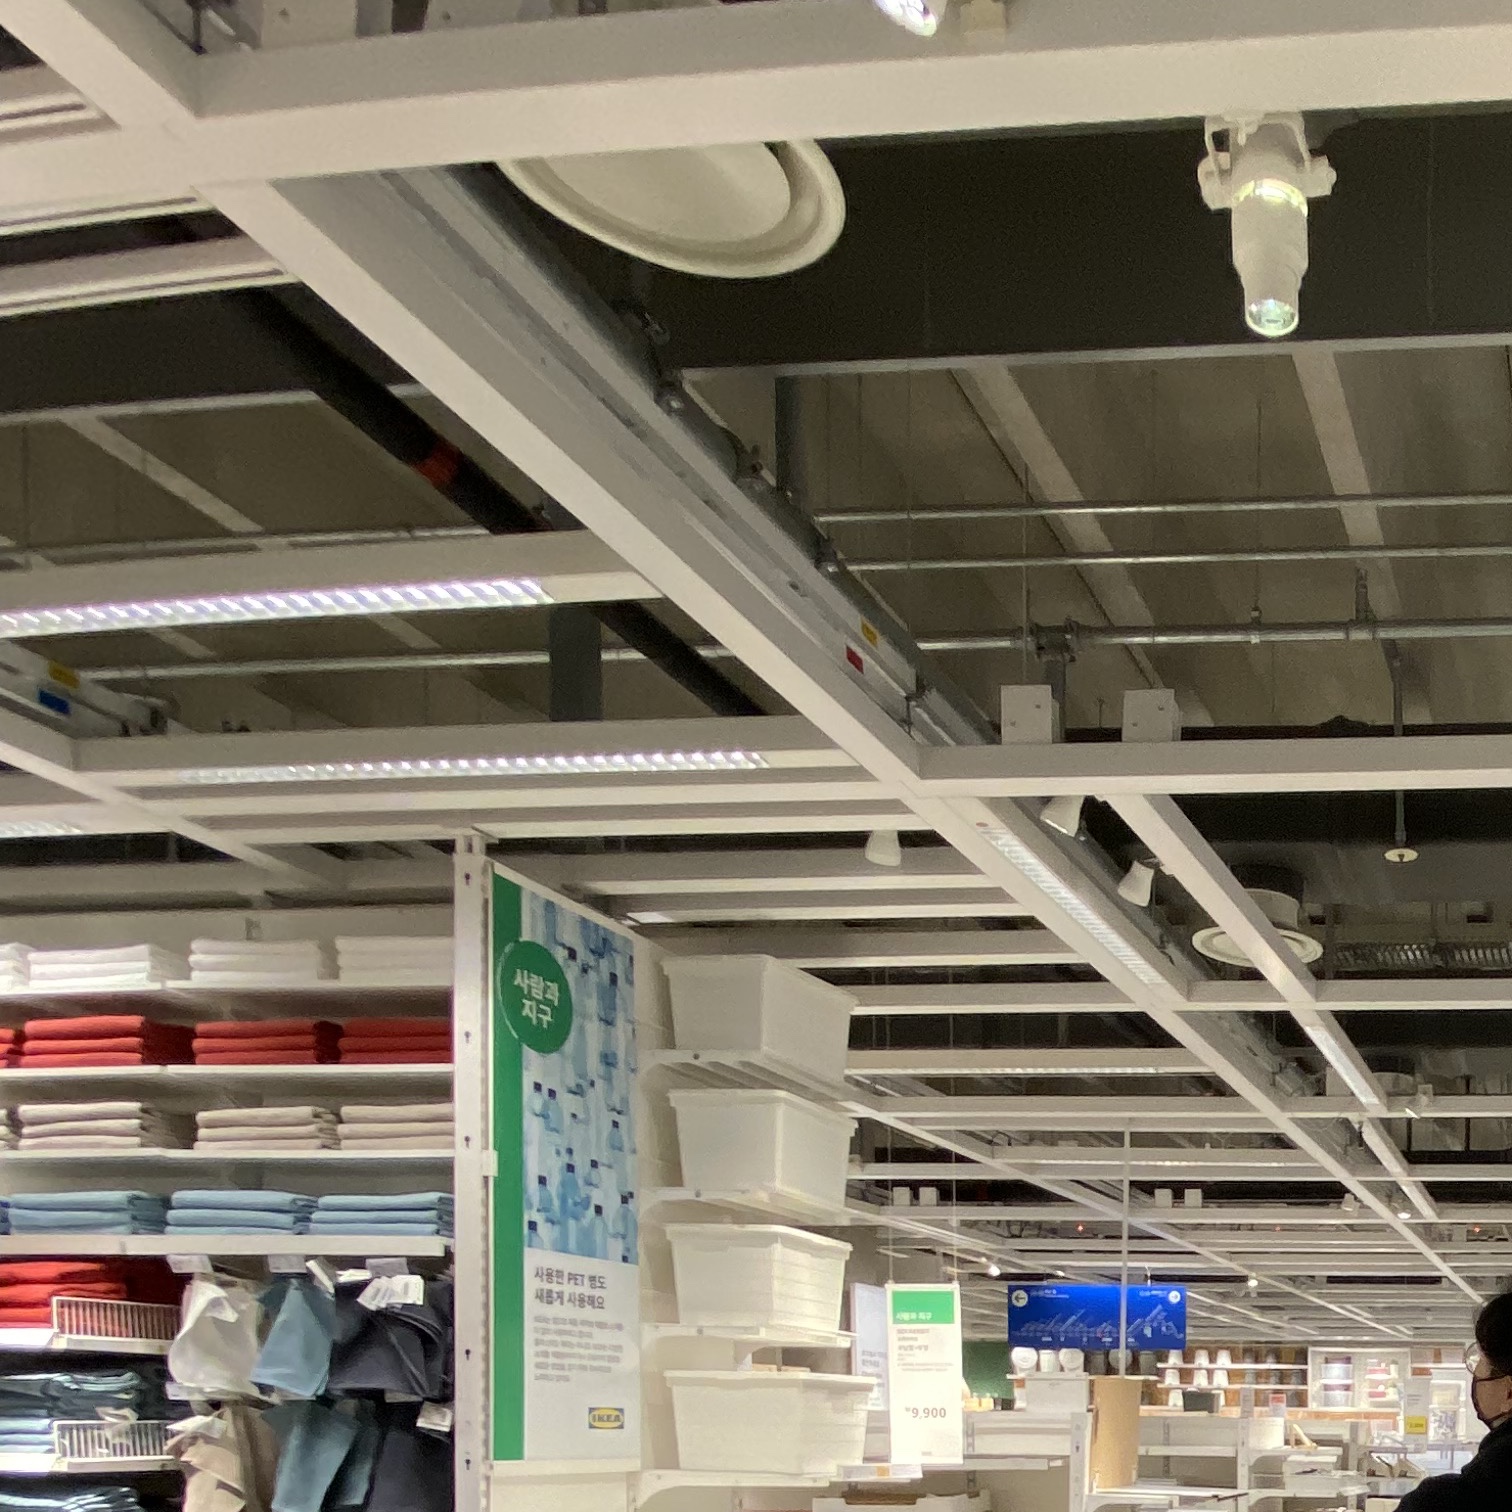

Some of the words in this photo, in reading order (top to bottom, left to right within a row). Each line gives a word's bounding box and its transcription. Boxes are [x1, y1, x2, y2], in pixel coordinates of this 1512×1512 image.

[513, 968, 559, 1006] 사람과
[521, 999, 552, 1029] 지구
[567, 1271, 585, 1286] PET
